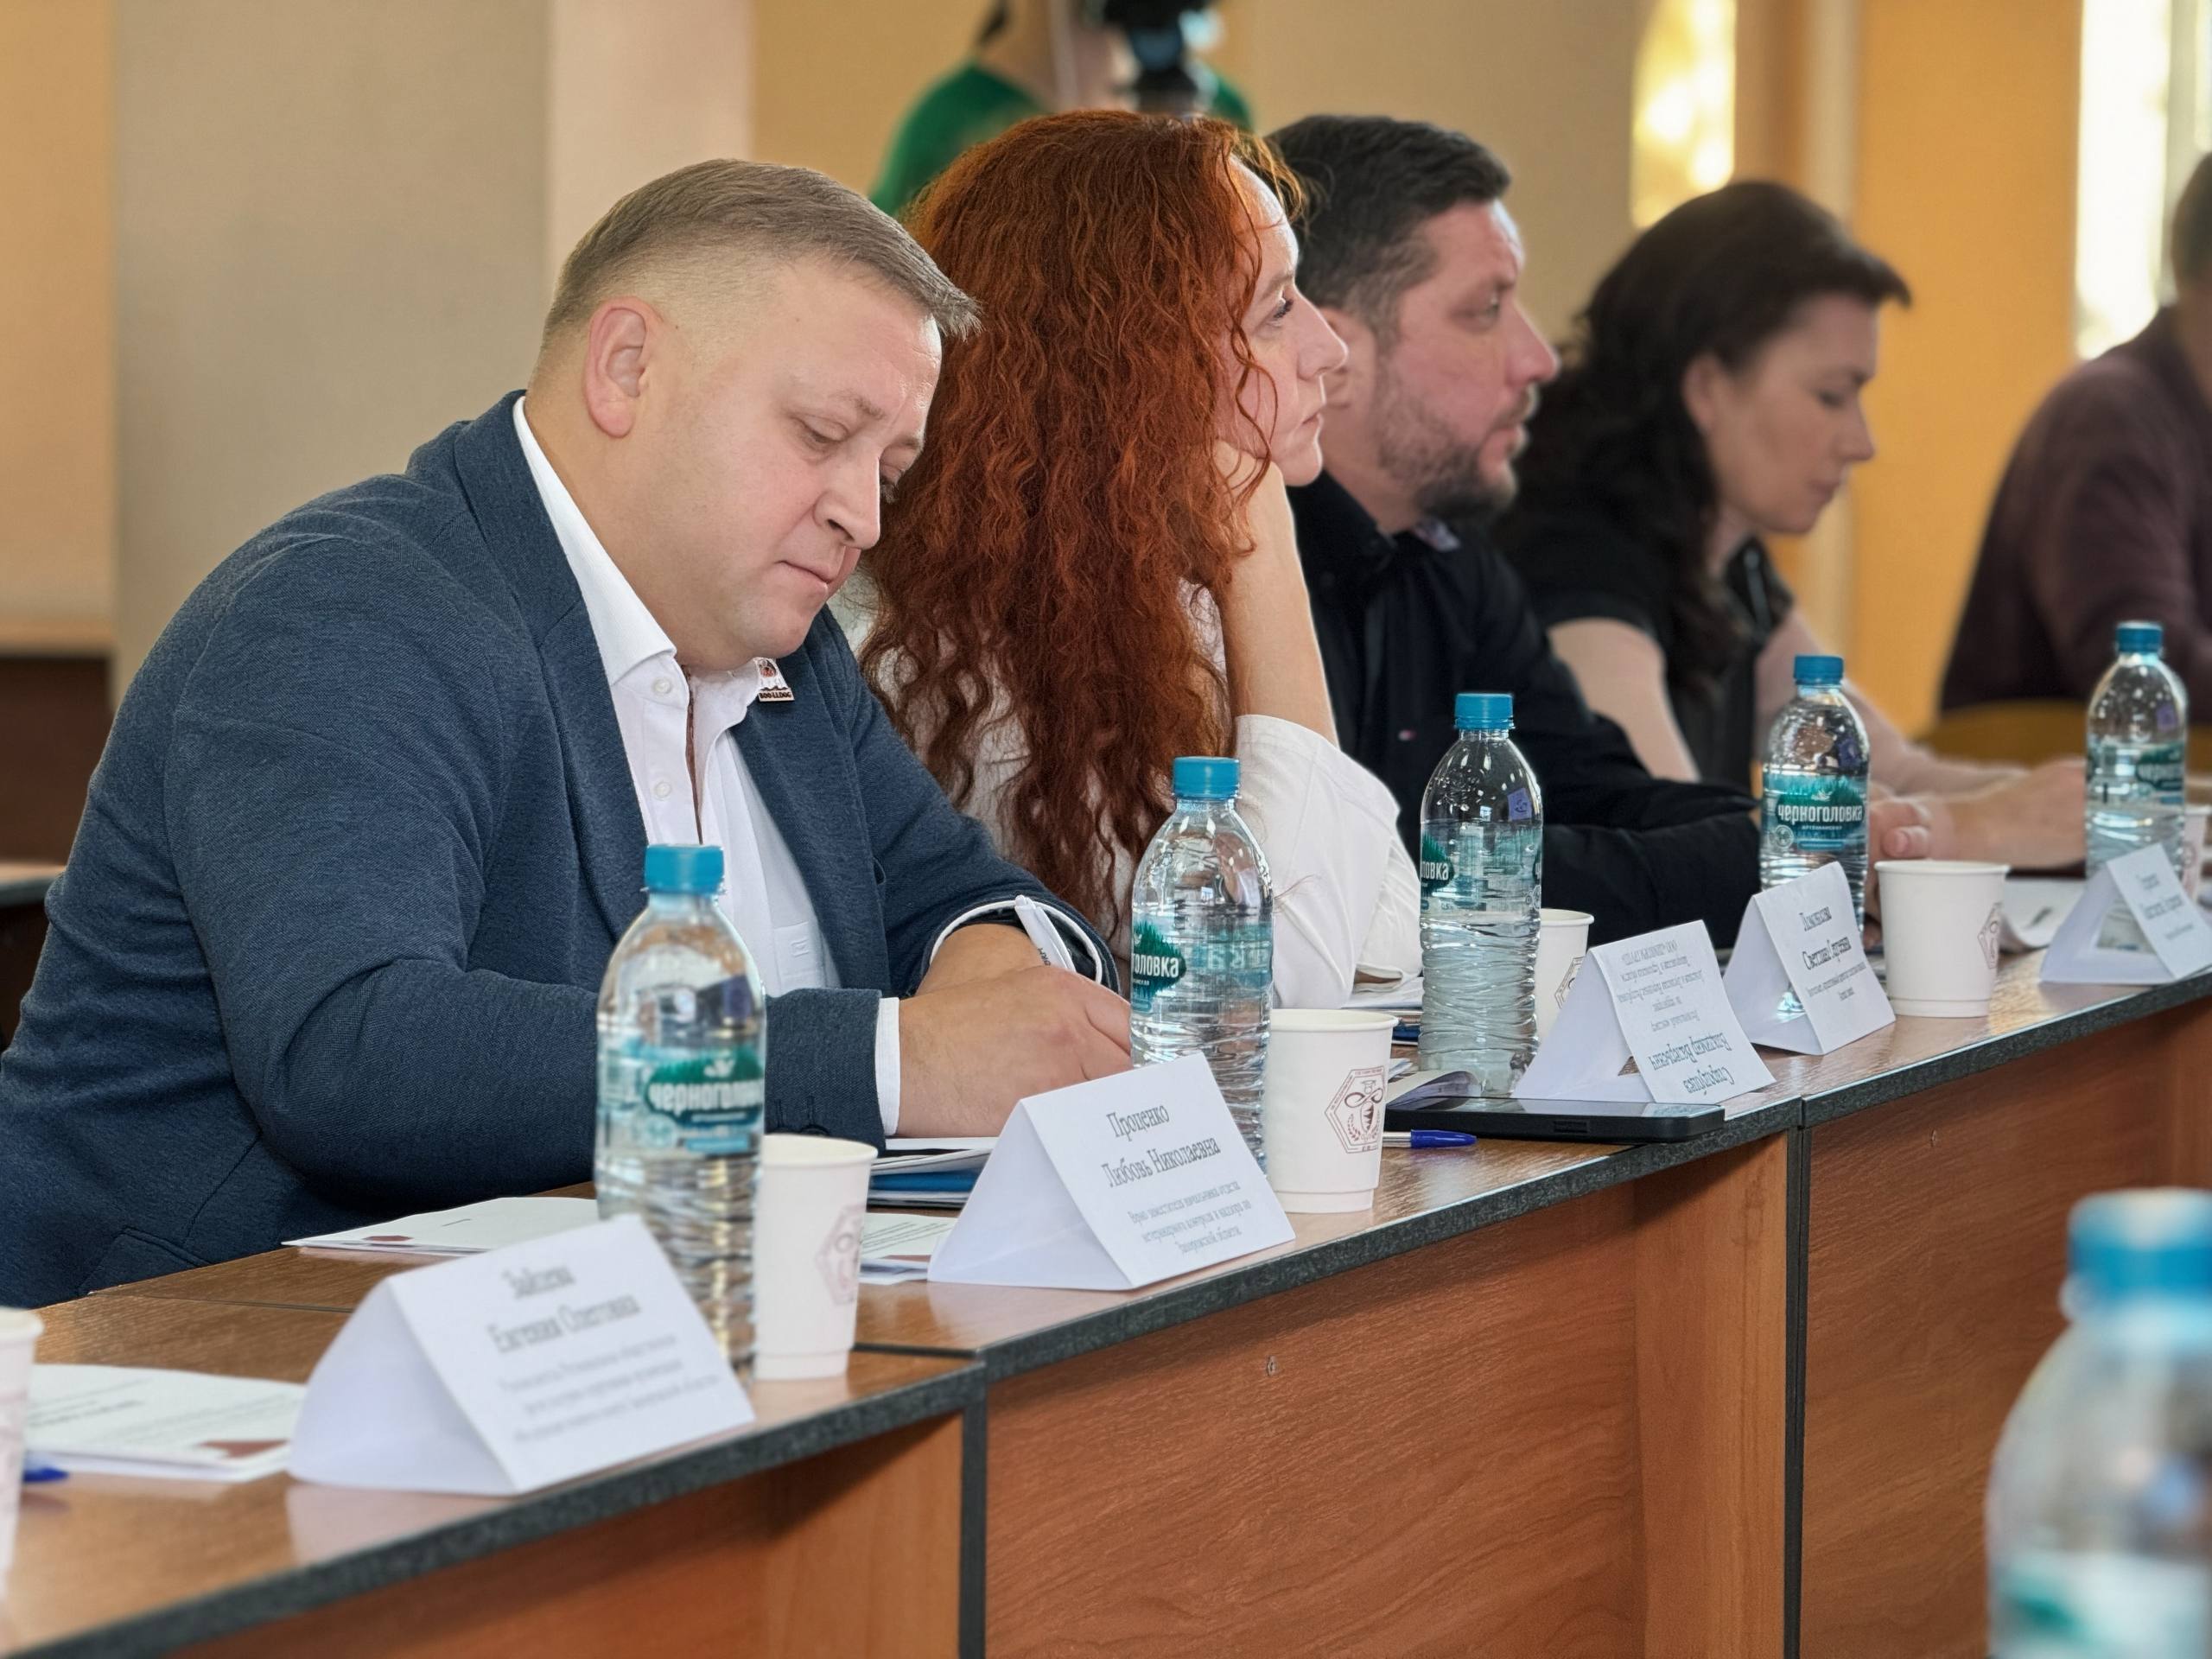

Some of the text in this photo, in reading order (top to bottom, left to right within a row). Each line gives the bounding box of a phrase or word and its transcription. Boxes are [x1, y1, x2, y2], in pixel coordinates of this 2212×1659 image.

[1777, 804, 1862, 825] черноголовка
[1106, 1103, 1170, 1141] Проценко
[1101, 1137, 1222, 1187] Любовь Николаевна
